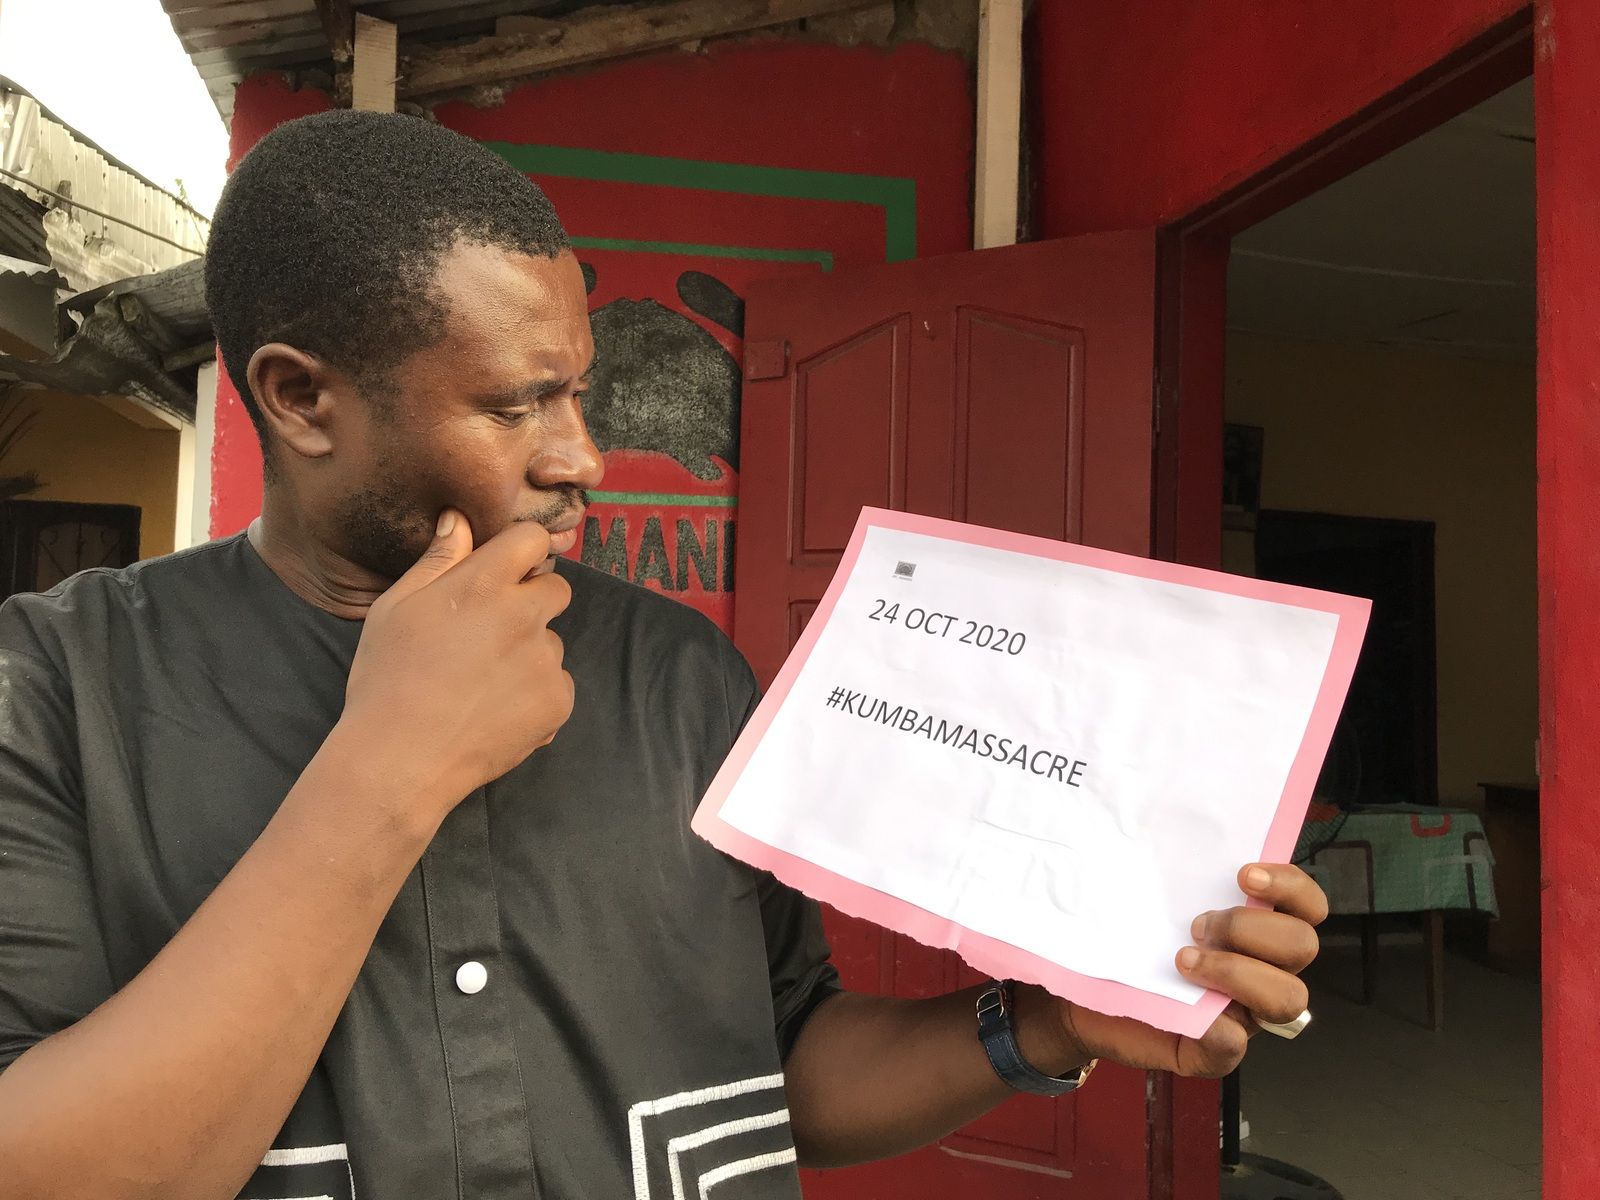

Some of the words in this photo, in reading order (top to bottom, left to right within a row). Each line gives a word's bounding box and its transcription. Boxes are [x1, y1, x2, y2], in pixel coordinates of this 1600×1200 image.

[868, 599, 901, 624] 24
[904, 608, 959, 638] OCT
[958, 620, 1026, 656] 2020
[826, 686, 1088, 788] #KUMBAMASSACRE
